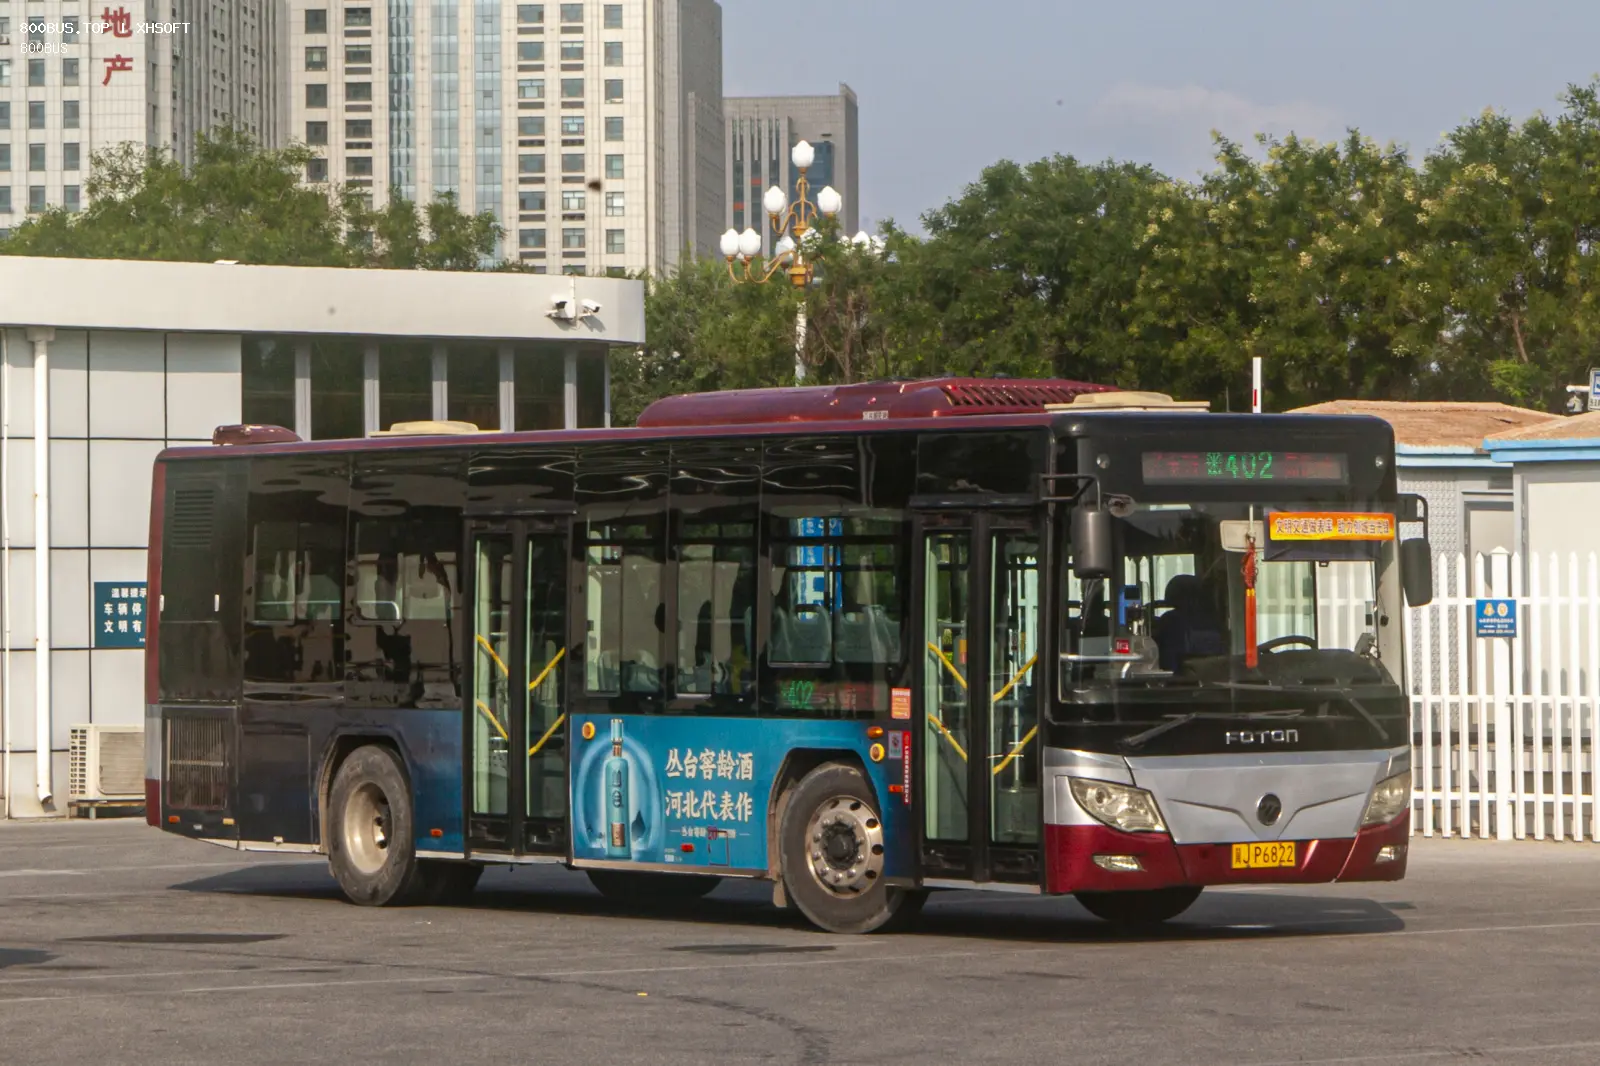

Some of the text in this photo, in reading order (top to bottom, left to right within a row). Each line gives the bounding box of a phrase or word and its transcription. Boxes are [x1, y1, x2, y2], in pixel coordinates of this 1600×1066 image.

[101, 6, 134, 86] 地产
[1225, 728, 1299, 744] FOTON
[665, 747, 753, 780] 丛台窖龄酒
[665, 788, 753, 822] 河北代表作
